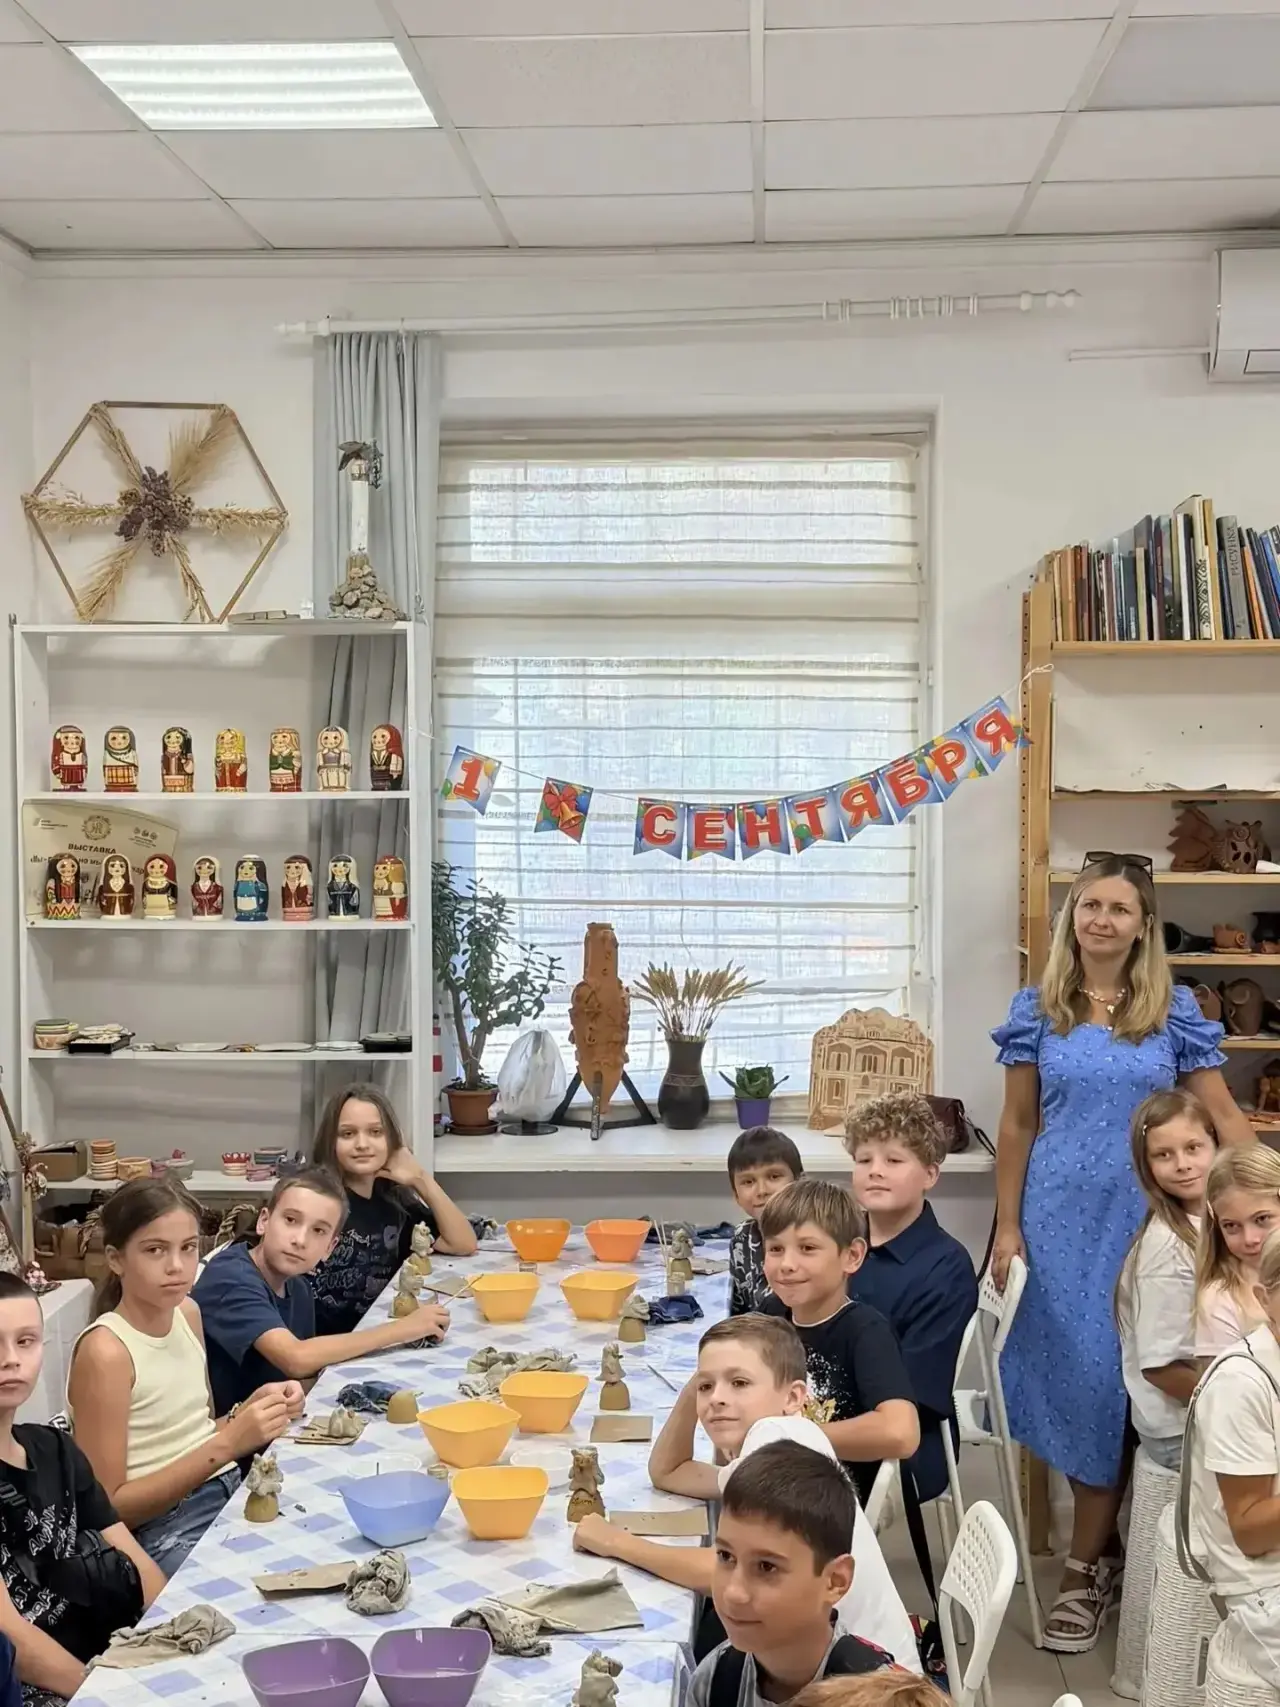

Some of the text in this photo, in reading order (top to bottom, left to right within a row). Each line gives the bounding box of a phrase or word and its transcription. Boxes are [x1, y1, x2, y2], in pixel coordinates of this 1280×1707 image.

[453, 706, 1019, 851] 1 СЕНТЯБРЯ
[68, 843, 117, 855] ВЫСТАВКА
